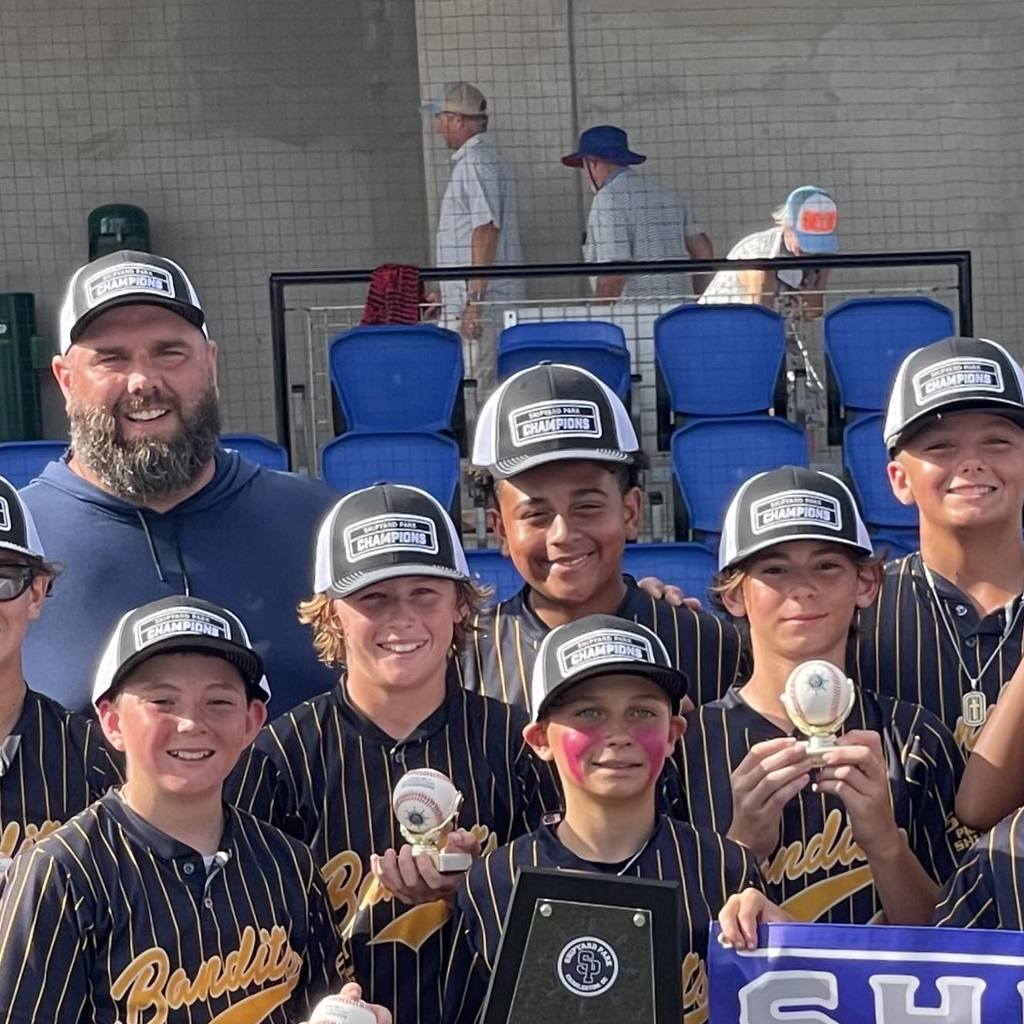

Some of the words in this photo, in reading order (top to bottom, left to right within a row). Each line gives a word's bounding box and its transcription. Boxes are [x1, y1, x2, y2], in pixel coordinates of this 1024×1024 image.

[96, 277, 163, 296] CHAMPIONS
[924, 373, 992, 393] CHAMPIONS
[522, 417, 591, 436] CHAMPIONS
[762, 506, 831, 524] CHAMPIONS
[356, 529, 427, 552] CHAMPIONS
[146, 621, 220, 641] CHAMPIONS
[570, 643, 643, 665] CHAMPIONS
